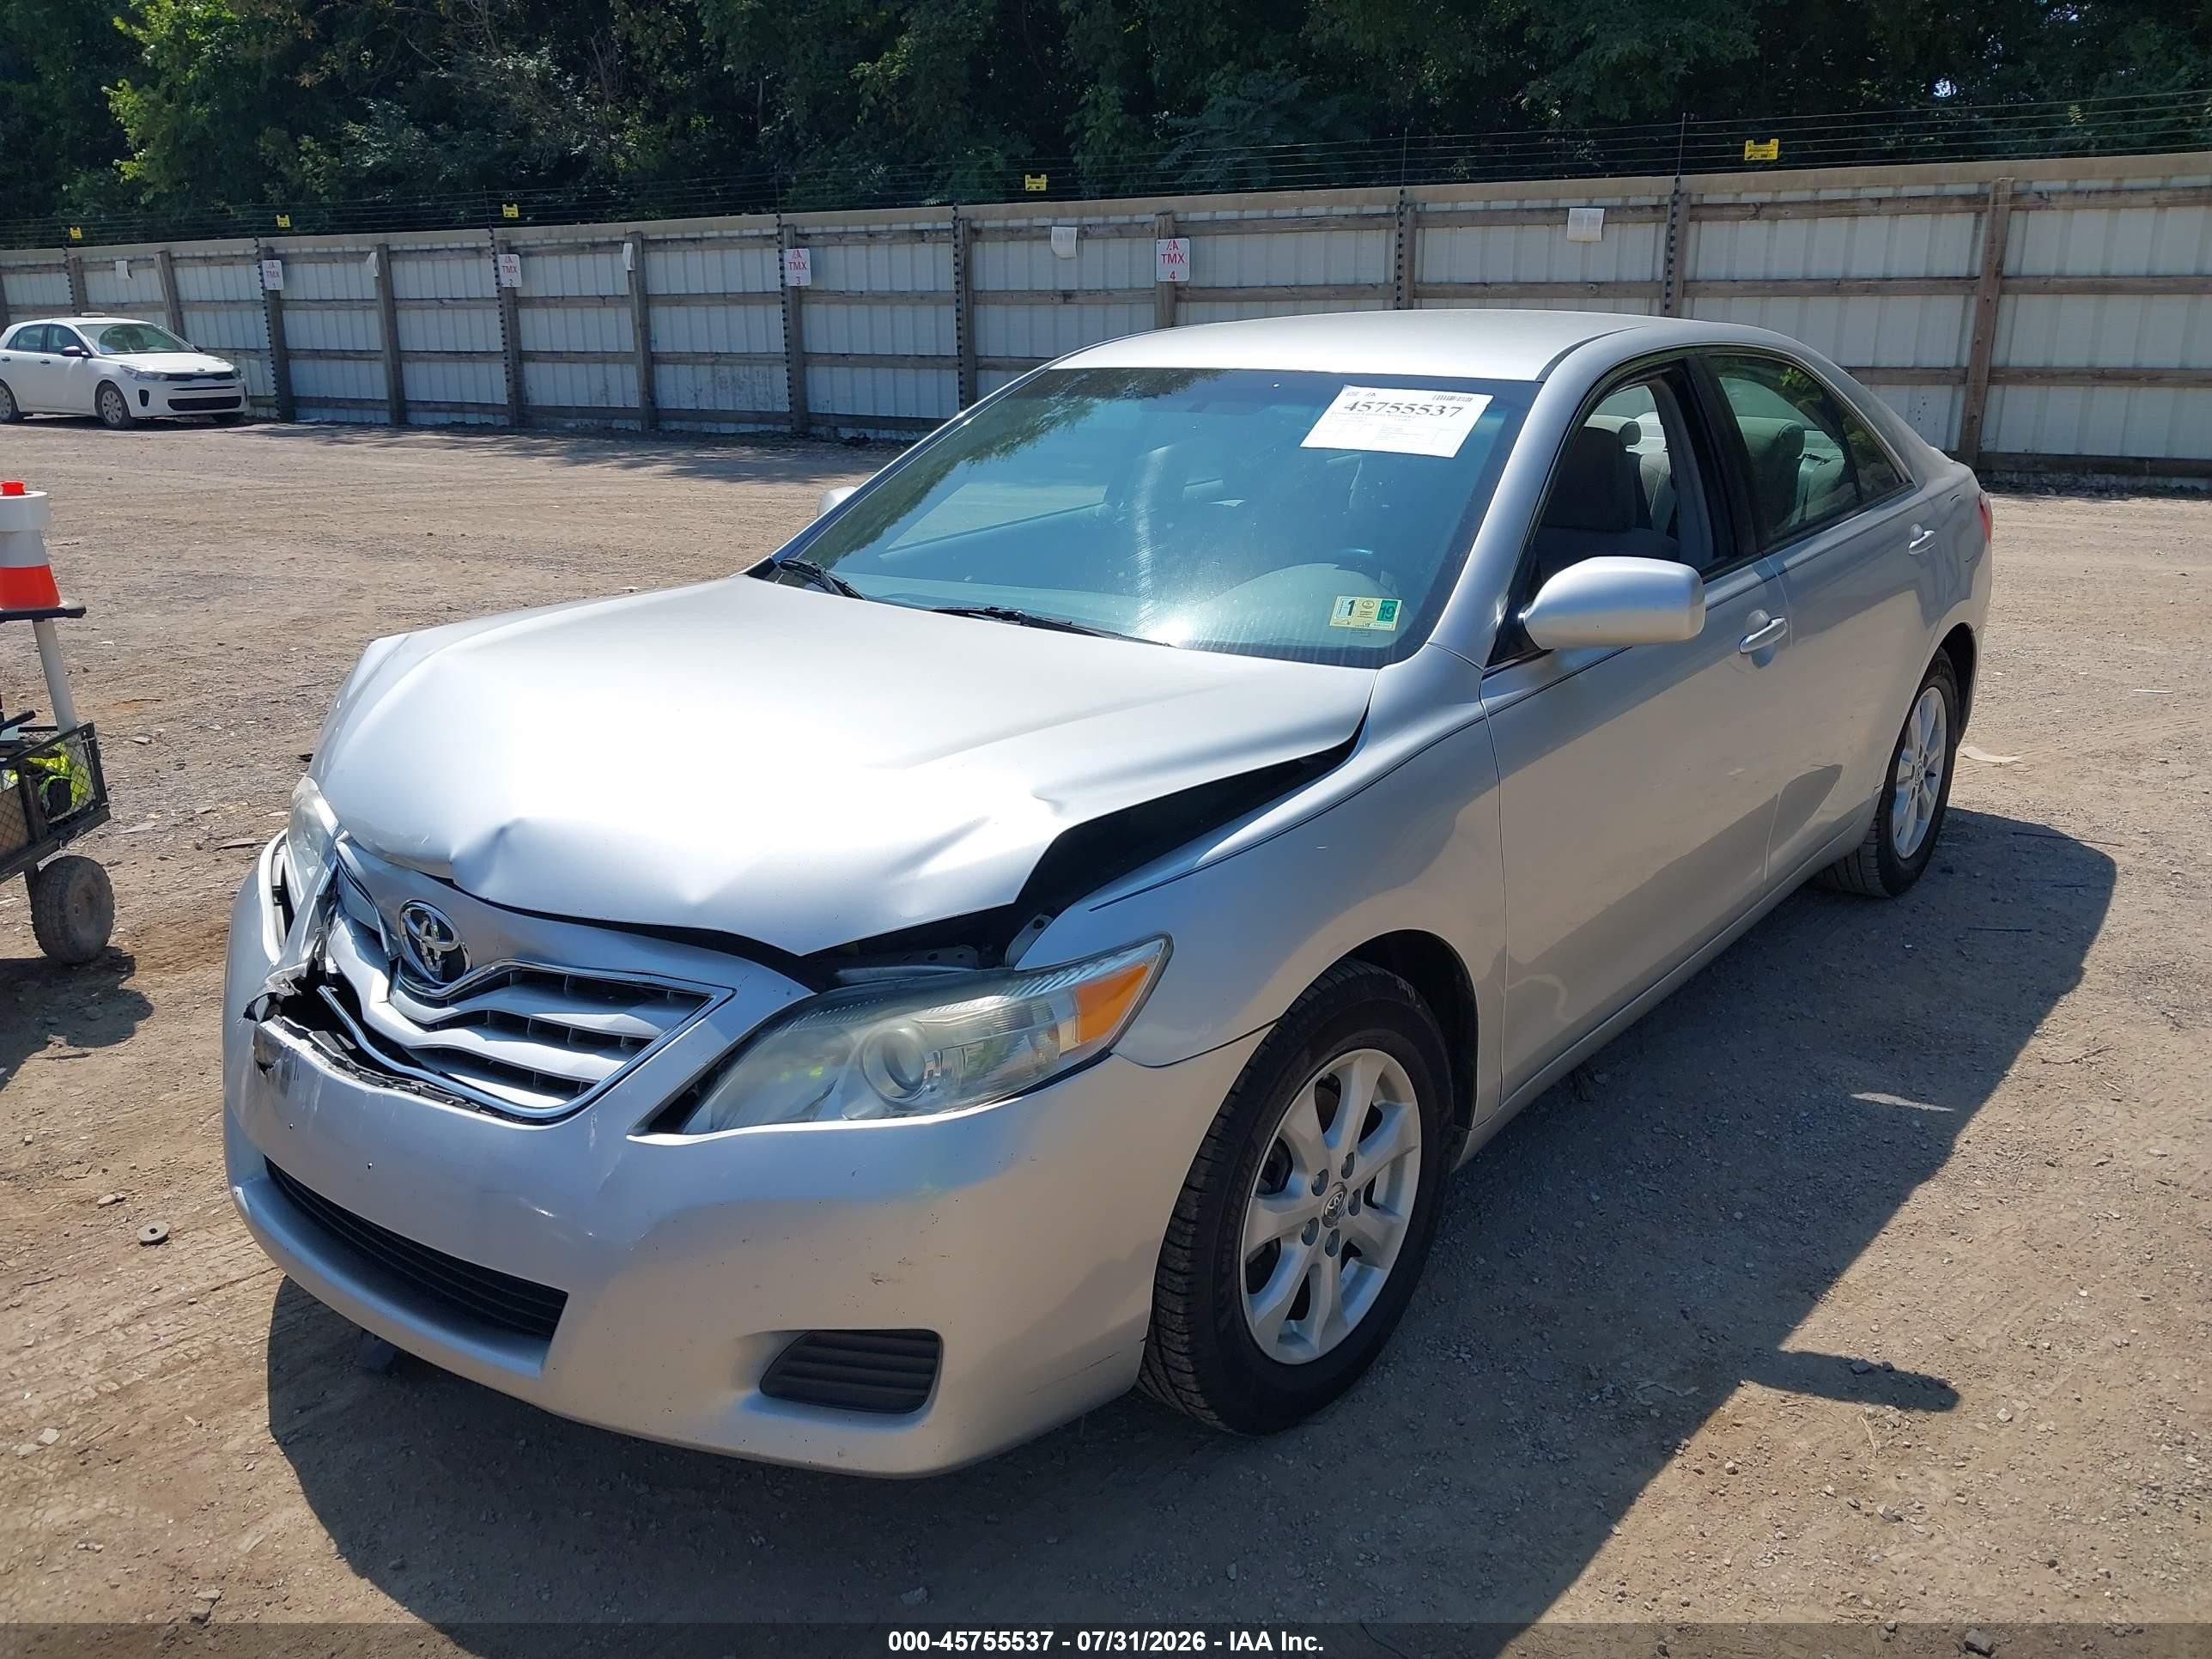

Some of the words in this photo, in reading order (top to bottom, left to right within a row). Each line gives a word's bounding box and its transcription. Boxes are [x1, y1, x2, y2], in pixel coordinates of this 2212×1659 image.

[1161, 252, 1185, 264] TMX
[501, 265, 519, 274] TMX
[788, 261, 807, 270] TMX
[1170, 270, 1176, 280] 4
[1343, 400, 1464, 417] 45755537
[1346, 599, 1356, 617] 1
